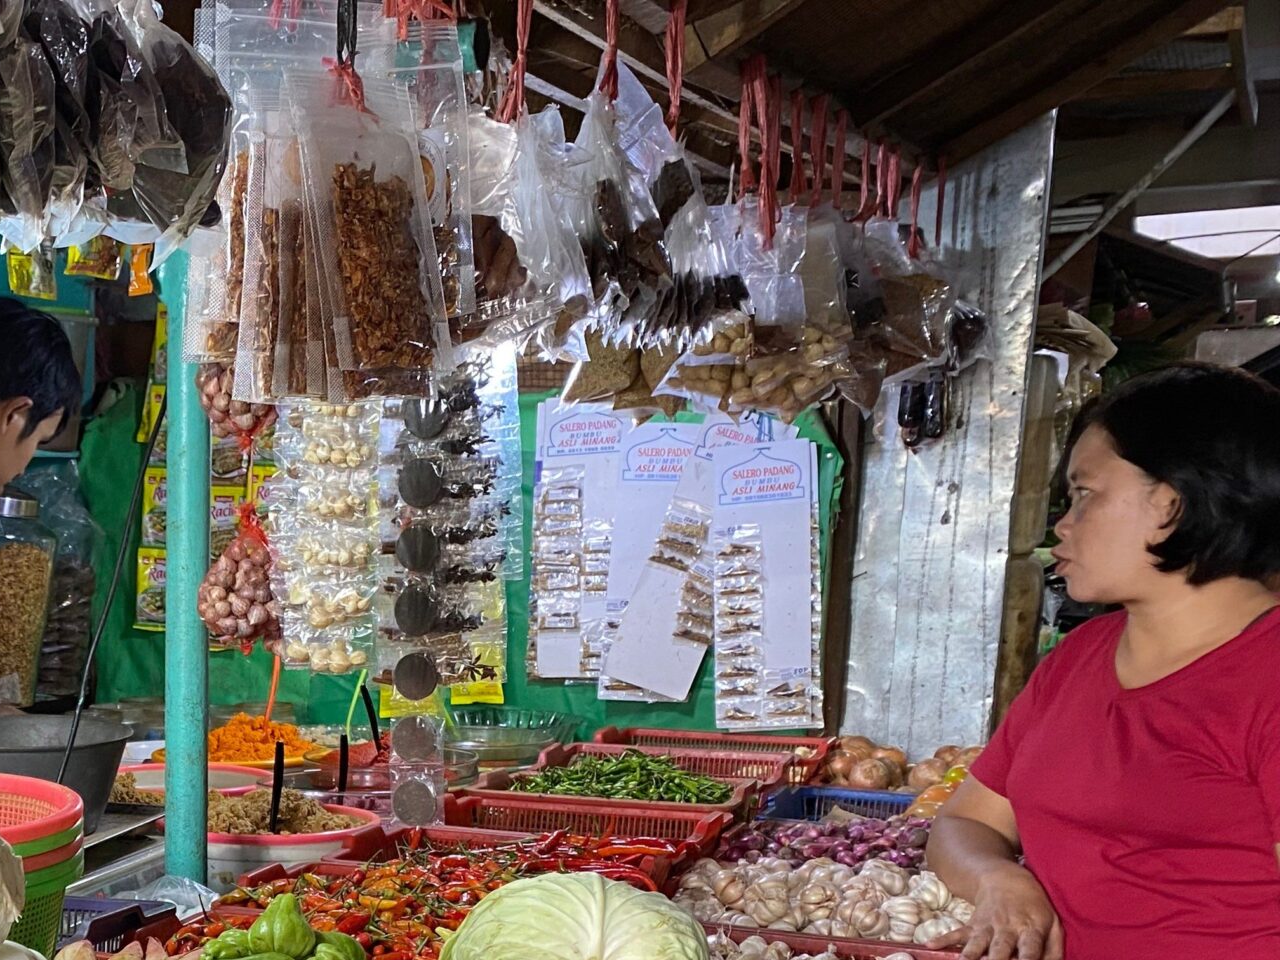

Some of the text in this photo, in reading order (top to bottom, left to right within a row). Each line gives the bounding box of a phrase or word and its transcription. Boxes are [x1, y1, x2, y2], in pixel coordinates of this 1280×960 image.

[559, 419, 617, 432] SALERO PADANG
[716, 427, 744, 442] SALERO
[558, 436, 616, 448] ASLI MINANG
[638, 447, 693, 457] SALERO PADAN
[635, 464, 683, 473] ASLI MINA
[732, 465, 795, 480] SALERO PADANG
[732, 482, 796, 496] ASLI MINANG
